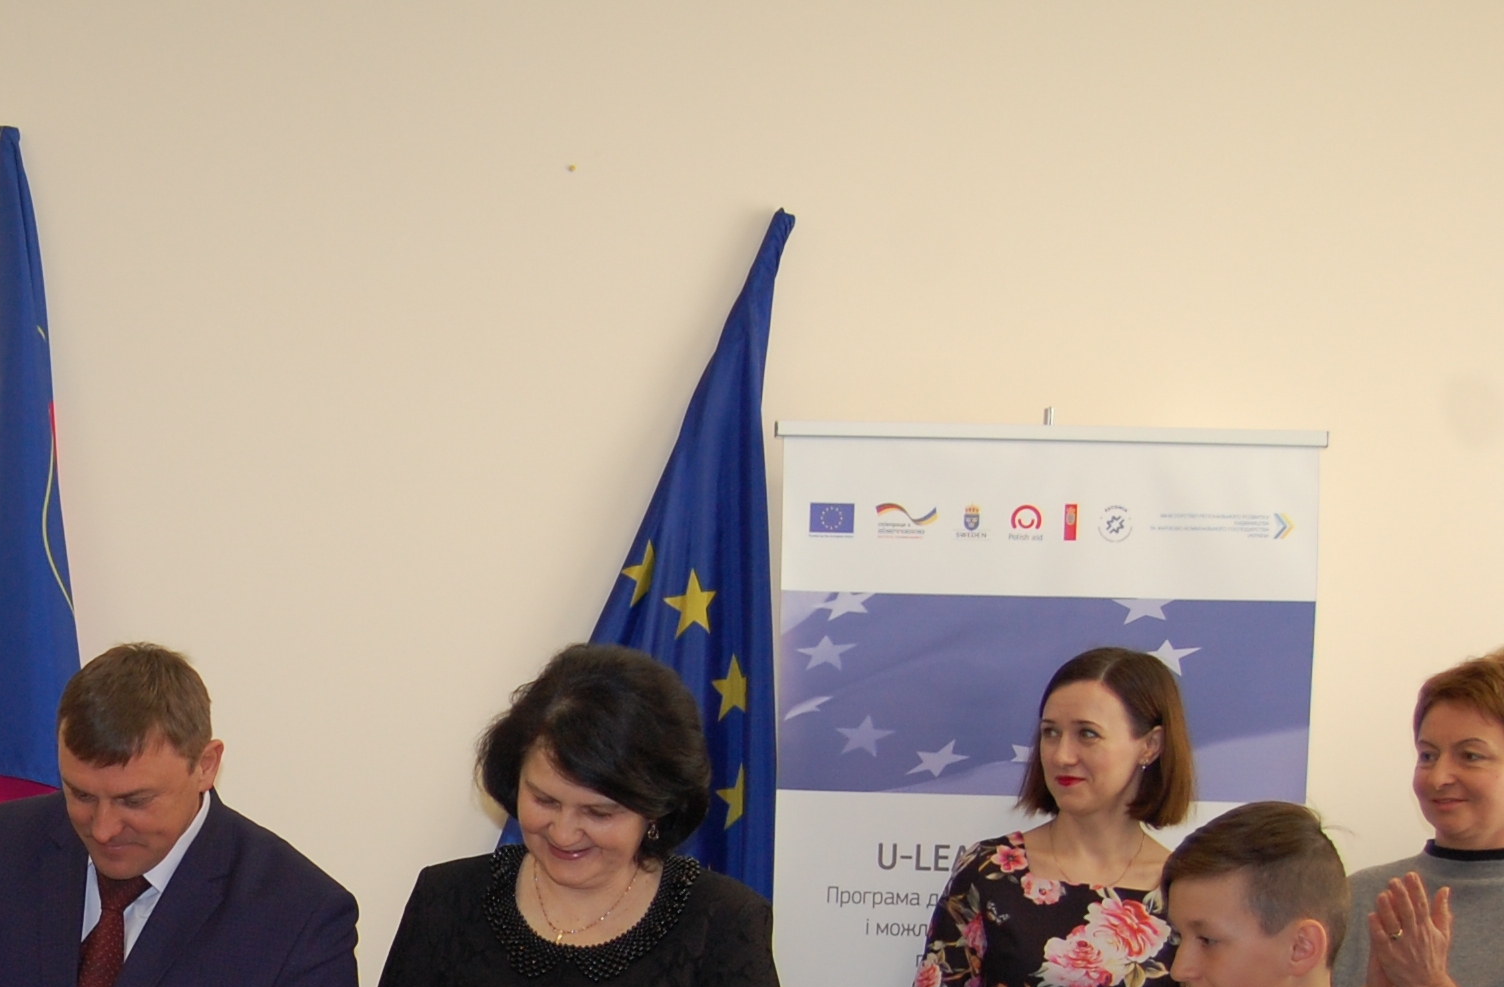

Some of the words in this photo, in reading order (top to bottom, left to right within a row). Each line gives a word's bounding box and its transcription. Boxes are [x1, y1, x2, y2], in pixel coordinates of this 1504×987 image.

[1008, 533, 1029, 541] Polish
[1031, 533, 1043, 541] aid
[877, 842, 968, 872] U-LEA
[826, 886, 920, 909] Програма
[926, 893, 939, 909] д
[876, 922, 928, 937] можл
